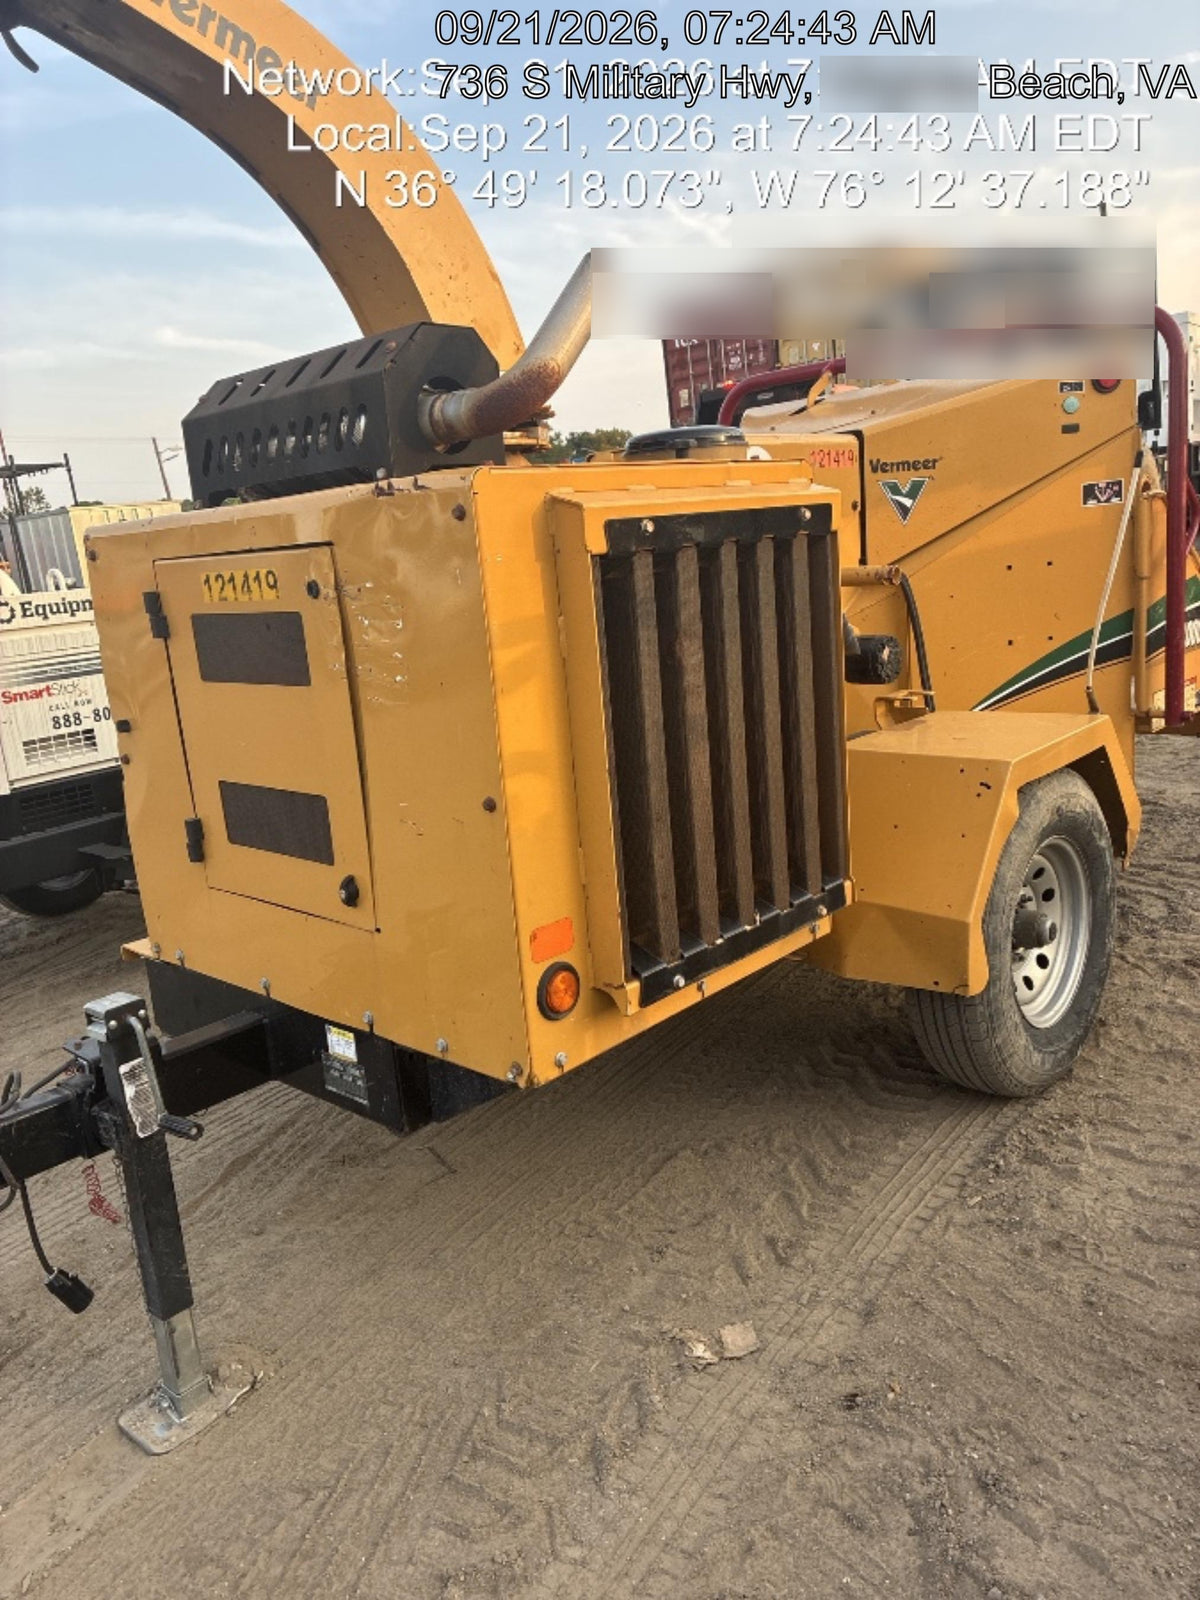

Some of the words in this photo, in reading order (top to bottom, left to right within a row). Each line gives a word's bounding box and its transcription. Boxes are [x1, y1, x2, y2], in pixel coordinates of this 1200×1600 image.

[154, 0, 317, 111] ermeer
[869, 457, 939, 474] Vermeer
[203, 570, 280, 601] 121419
